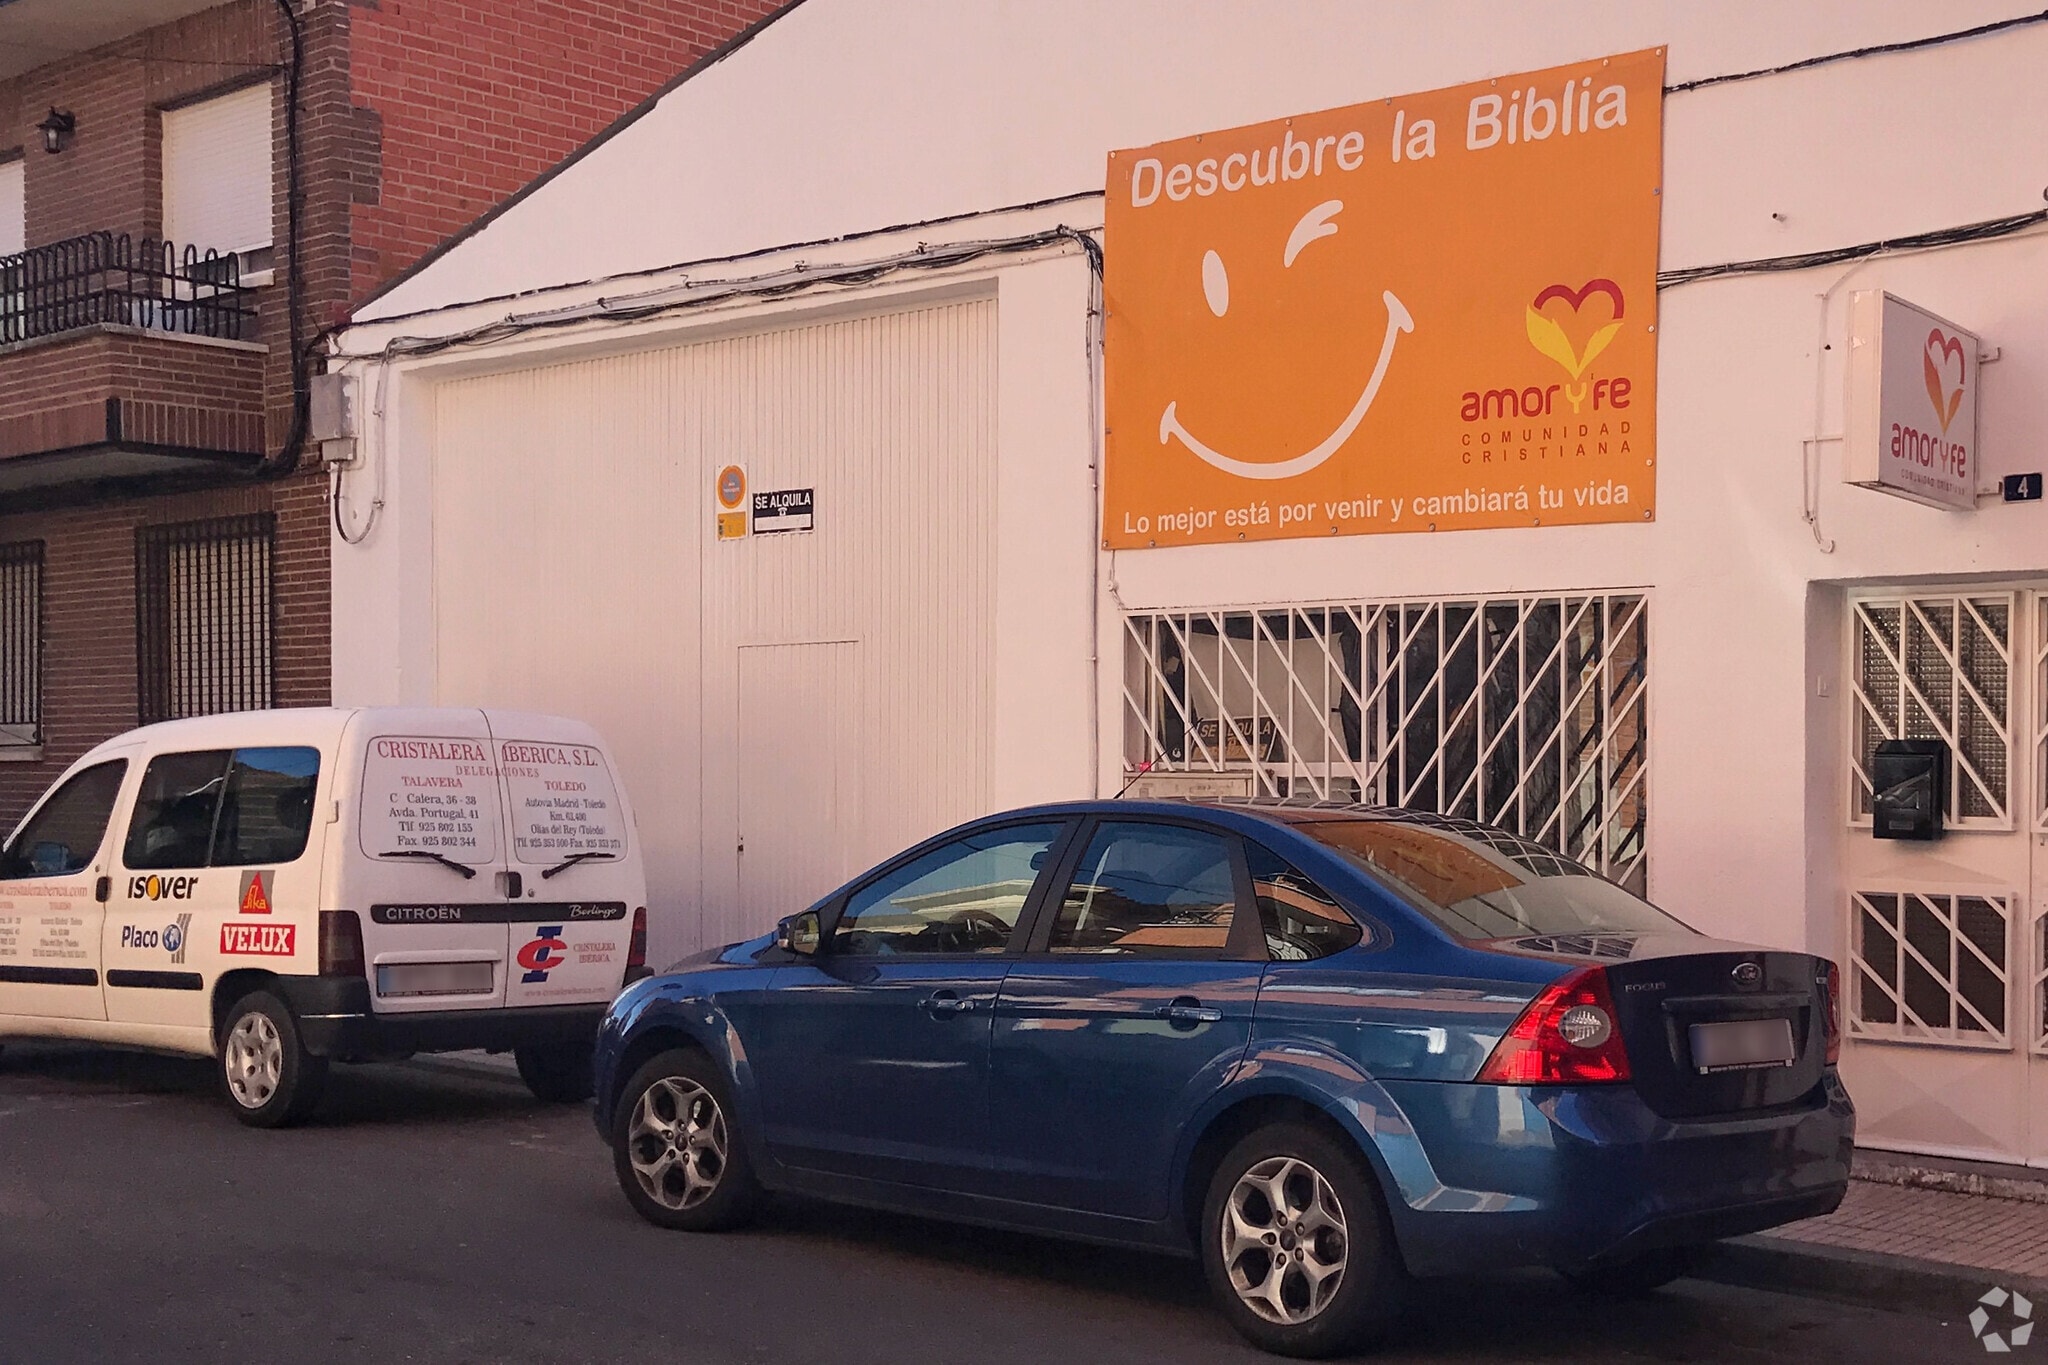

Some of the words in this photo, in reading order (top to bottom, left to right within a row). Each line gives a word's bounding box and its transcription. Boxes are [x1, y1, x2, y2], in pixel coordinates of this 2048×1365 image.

[1131, 129, 1365, 208] Descubre
[1392, 109, 1436, 163] la
[1466, 76, 1628, 151] Biblia
[1461, 421, 1631, 446] COMUNIDAD
[1461, 440, 1631, 464] CRISTIANA
[2017, 476, 2028, 498] 4
[755, 496, 768, 510] SE
[769, 492, 811, 508] ALQUILA
[1124, 511, 1150, 534] Lo
[1157, 506, 1217, 536] mejor
[1224, 500, 1270, 526] está
[1278, 501, 1316, 528] por
[1324, 494, 1383, 521] venir
[1390, 497, 1404, 523] y
[1412, 485, 1529, 517] cambiará
[1538, 484, 1564, 510] tu
[1573, 479, 1629, 507] vida
[1200, 724, 1218, 738] SE
[377, 741, 486, 761] CRISTALERA
[572, 749, 598, 767] S.L.
[455, 765, 540, 778] DELEGACIONES
[401, 776, 463, 788] TALAVERA
[544, 780, 586, 792] TOLEDO
[446, 795, 458, 805] 36
[465, 796, 477, 805] 38
[418, 822, 436, 832] 925
[437, 823, 455, 832] 802
[457, 823, 473, 832] 155
[563, 825, 577, 836] Rey
[422, 836, 439, 846] 925
[441, 836, 458, 846] 802
[459, 837, 476, 847] 344
[243, 885, 266, 909] Sika
[385, 905, 462, 920] CITROËN
[568, 905, 618, 919] Berlingo
[121, 925, 159, 948] Placo
[223, 926, 291, 953] VELUX
